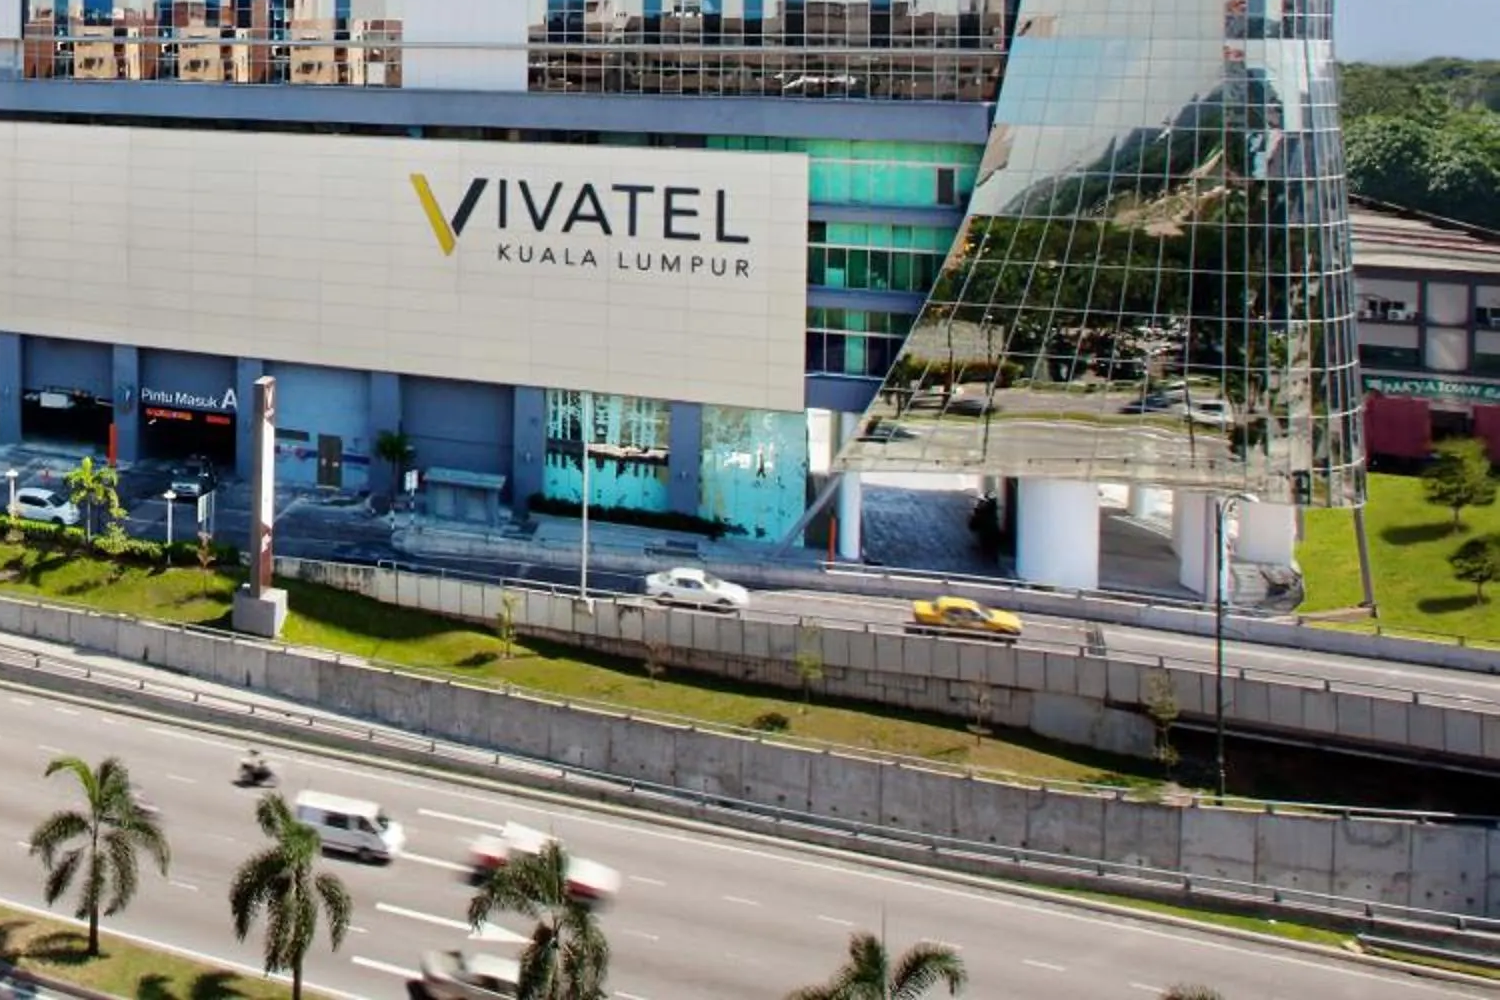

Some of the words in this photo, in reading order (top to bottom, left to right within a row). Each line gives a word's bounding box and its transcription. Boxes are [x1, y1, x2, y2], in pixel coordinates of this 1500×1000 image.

[410, 172, 750, 256] VIVATEL
[497, 243, 598, 267] KUALA
[617, 251, 750, 278] LUMPUR
[141, 387, 173, 403] Pintu
[175, 391, 218, 408] Masuk
[221, 387, 238, 409] A
